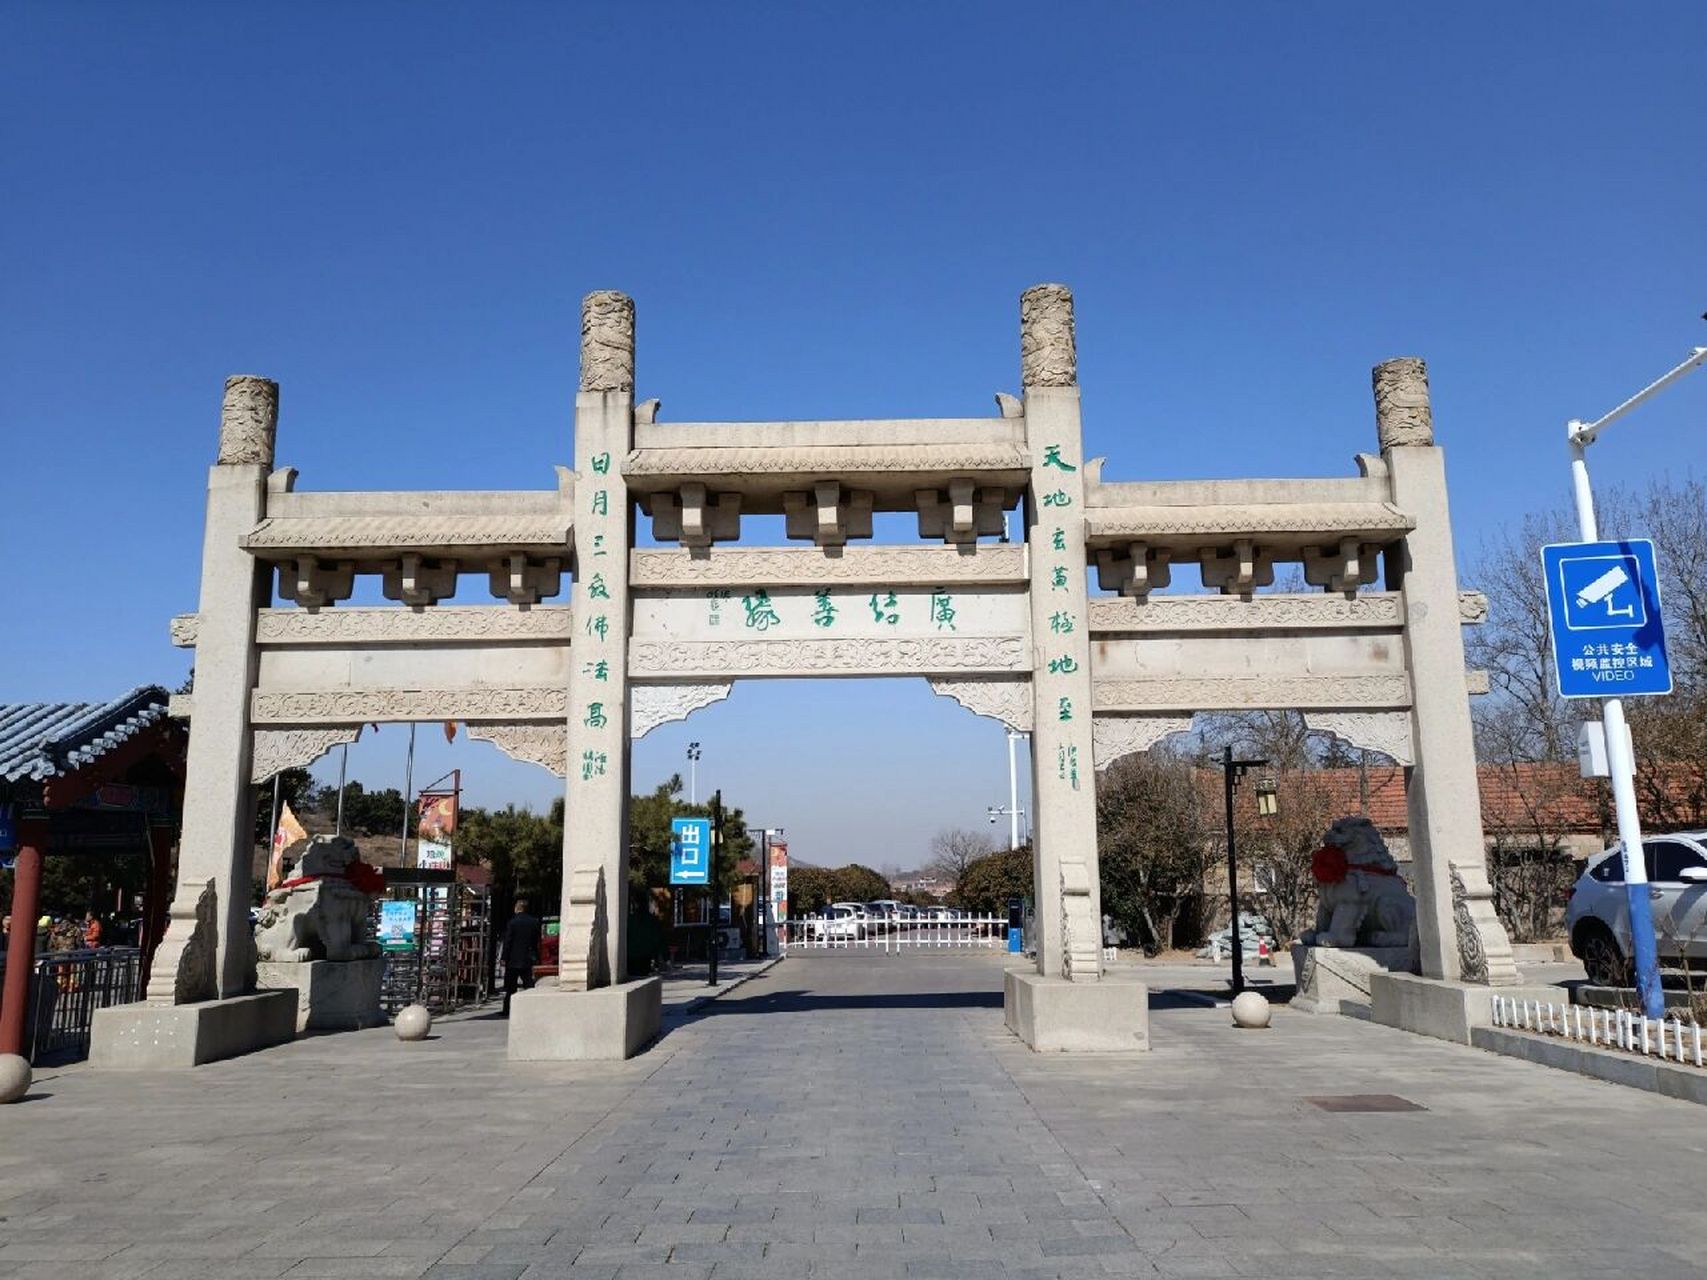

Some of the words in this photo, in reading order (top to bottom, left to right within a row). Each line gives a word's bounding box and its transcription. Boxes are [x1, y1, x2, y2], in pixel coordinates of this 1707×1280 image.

[1582, 643, 1639, 656] 公共安全
[1571, 656, 1654, 671] 视频监控区域
[1591, 670, 1635, 682] VIDEO
[681, 824, 700, 865] 出口
